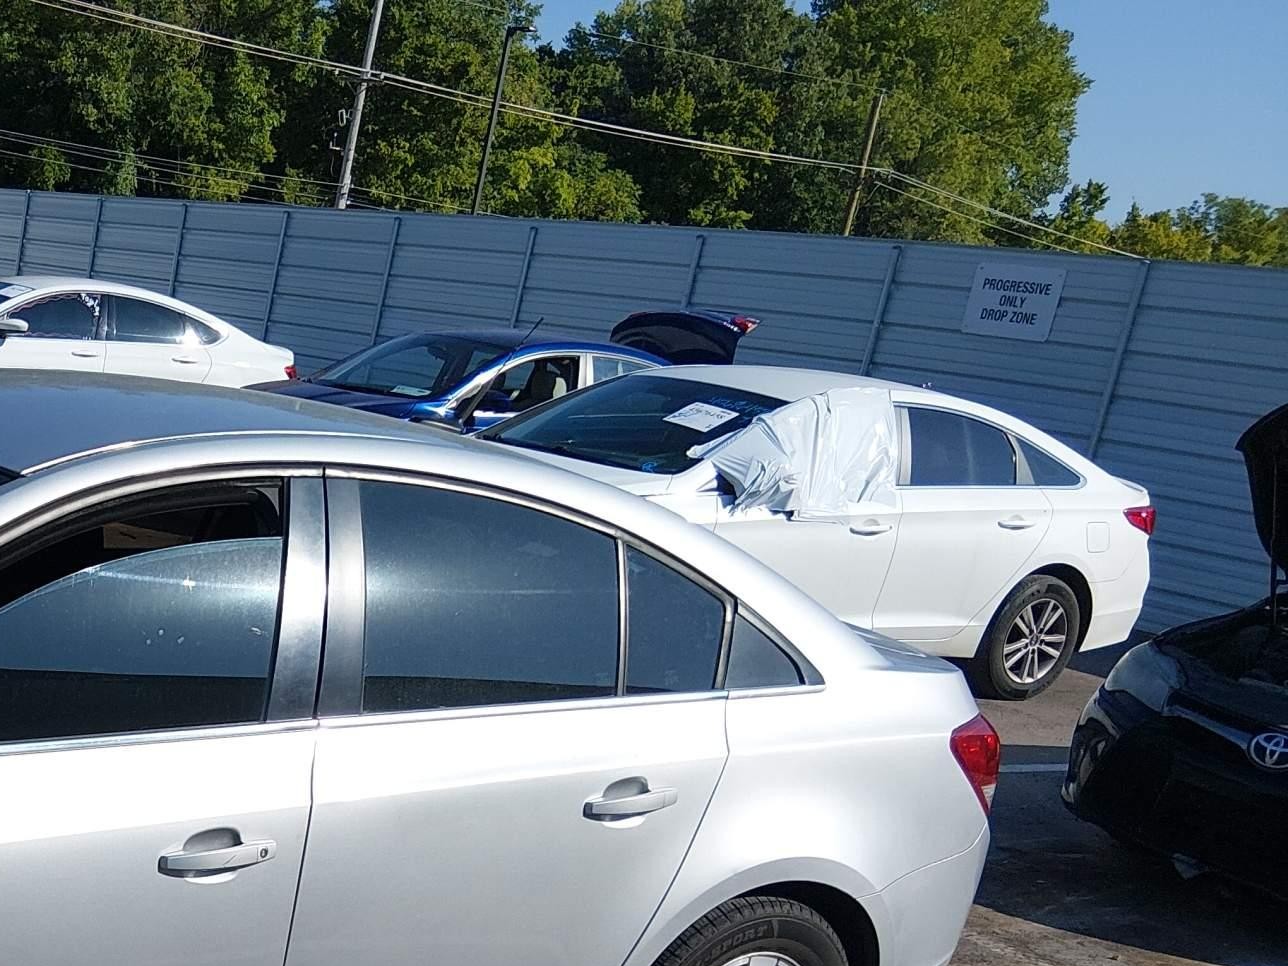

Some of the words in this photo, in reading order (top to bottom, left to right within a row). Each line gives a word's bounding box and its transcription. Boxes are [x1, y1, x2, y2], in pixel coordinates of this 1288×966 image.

[982, 278, 1052, 295] PROGRESSIVE
[999, 295, 1027, 308] ONLY
[980, 307, 1009, 322] DROP
[1009, 311, 1037, 326] ZONE
